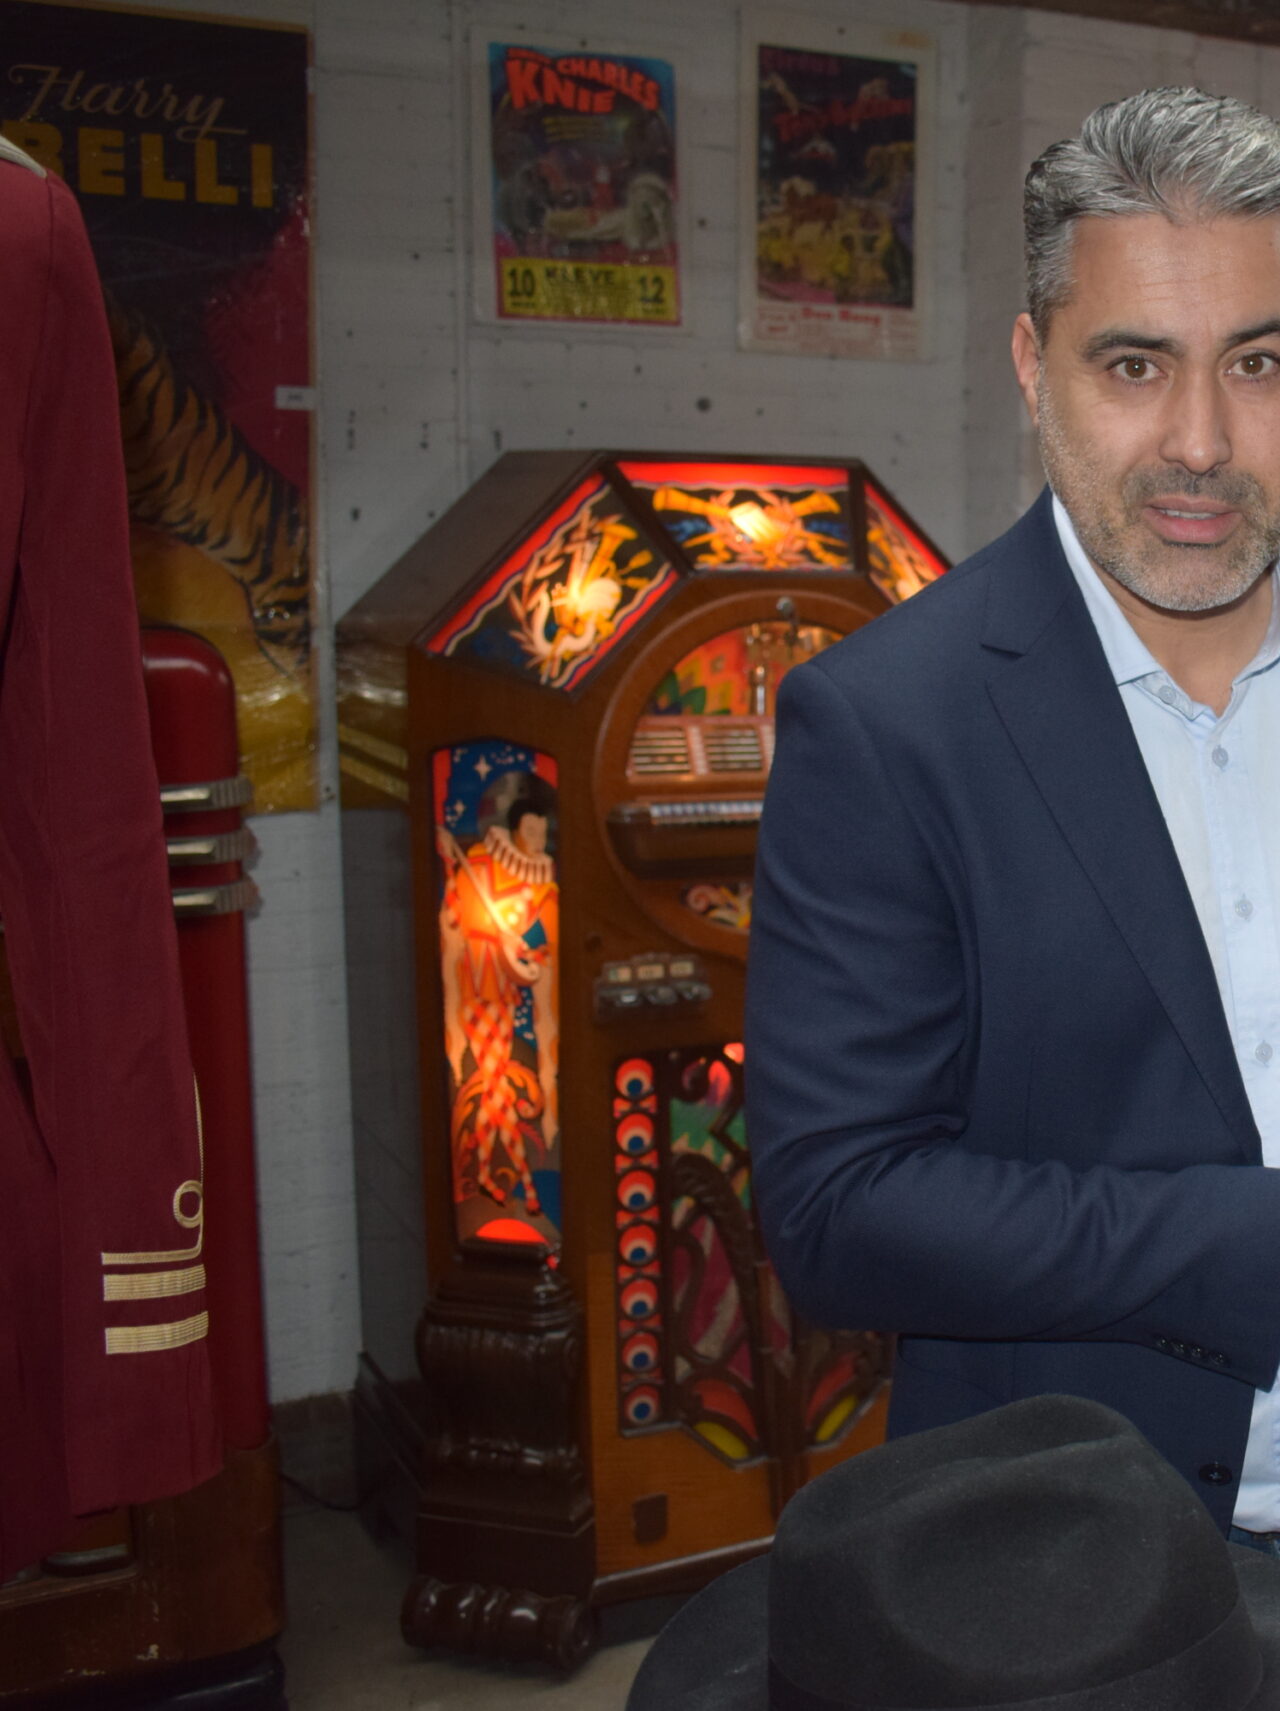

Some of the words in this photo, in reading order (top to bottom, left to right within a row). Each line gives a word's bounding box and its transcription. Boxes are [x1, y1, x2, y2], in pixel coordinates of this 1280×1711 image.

[8, 63, 249, 143] Harry
[505, 58, 616, 114] KNIE
[555, 56, 661, 111] CHARLES
[508, 266, 536, 297] 10
[638, 275, 665, 304] 12
